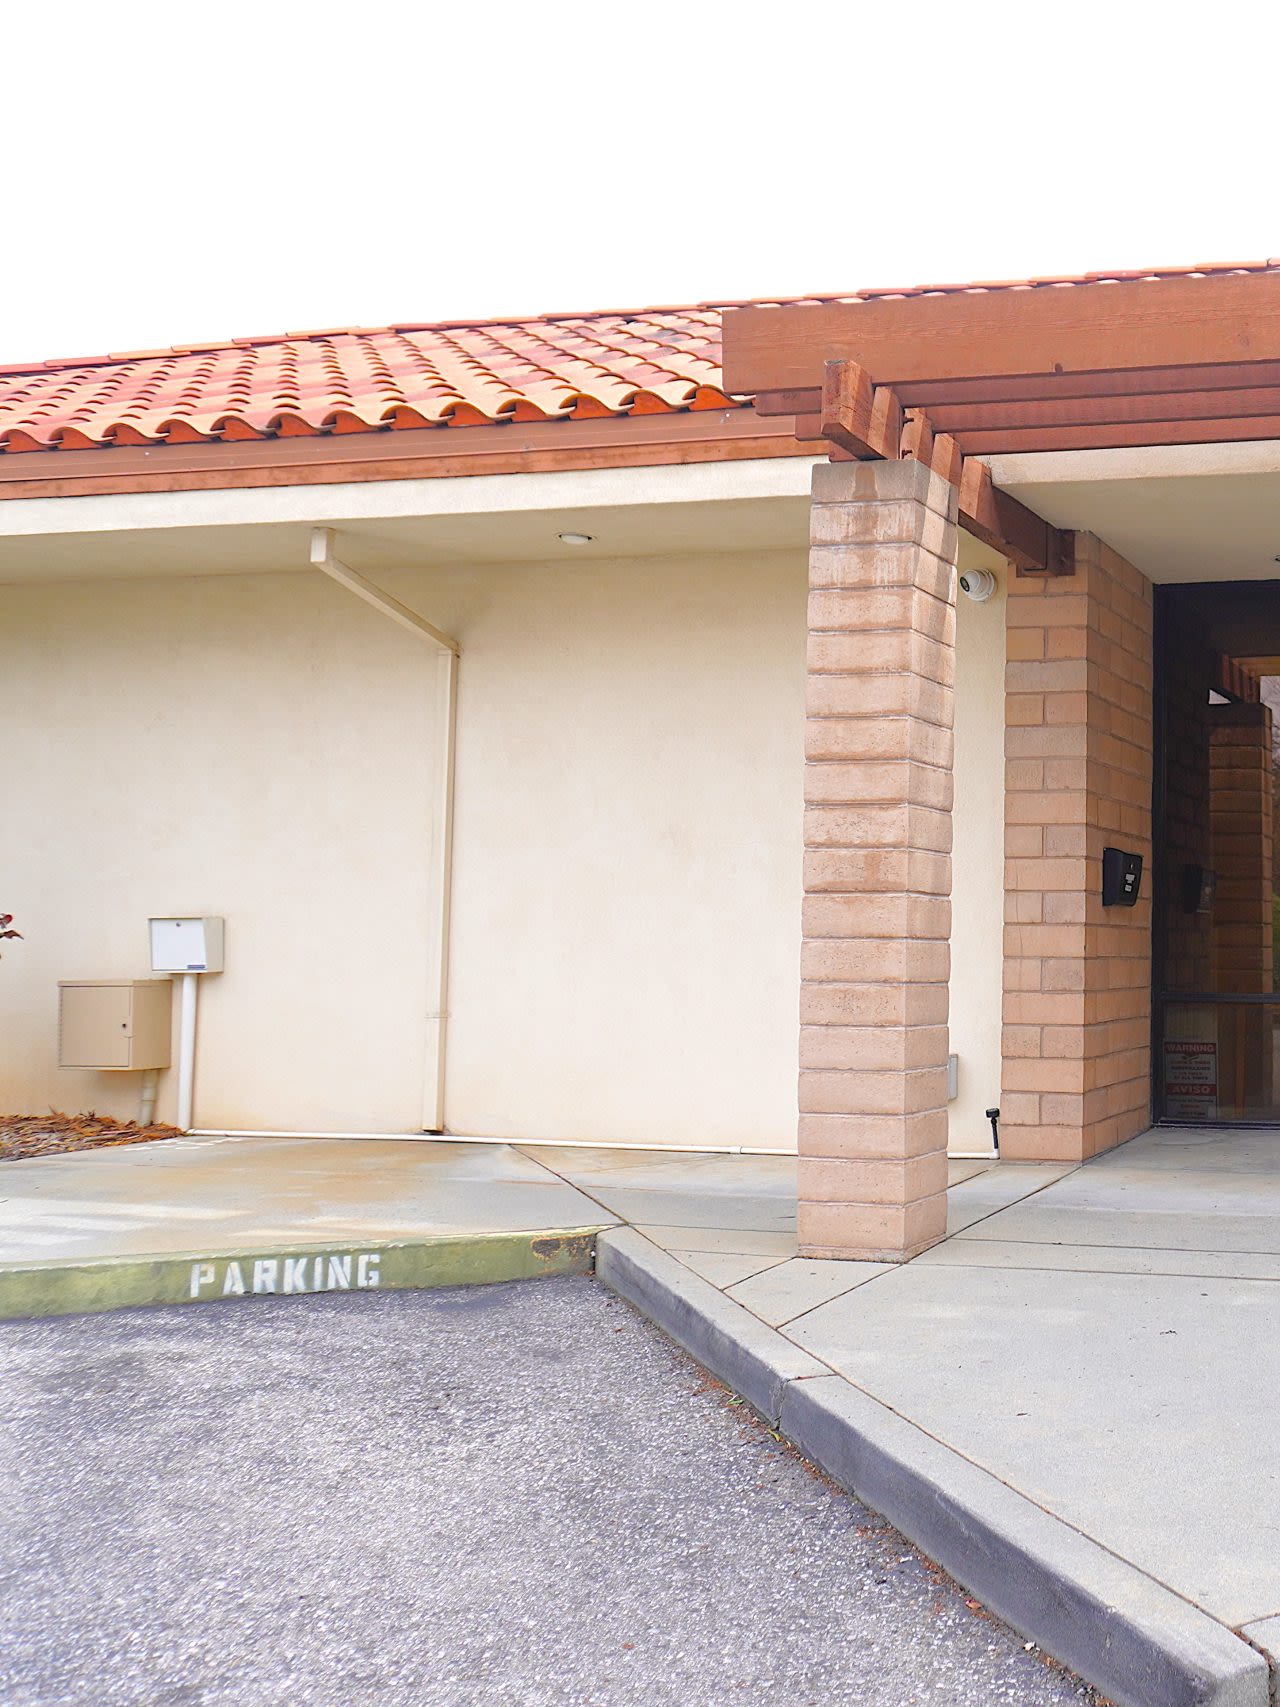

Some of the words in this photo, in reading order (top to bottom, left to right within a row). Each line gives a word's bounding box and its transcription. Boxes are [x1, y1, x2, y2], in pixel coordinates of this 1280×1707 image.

[1166, 1044, 1215, 1053] WARNING
[1171, 1085, 1209, 1094] AVISO
[190, 1254, 381, 1298] PARKING
